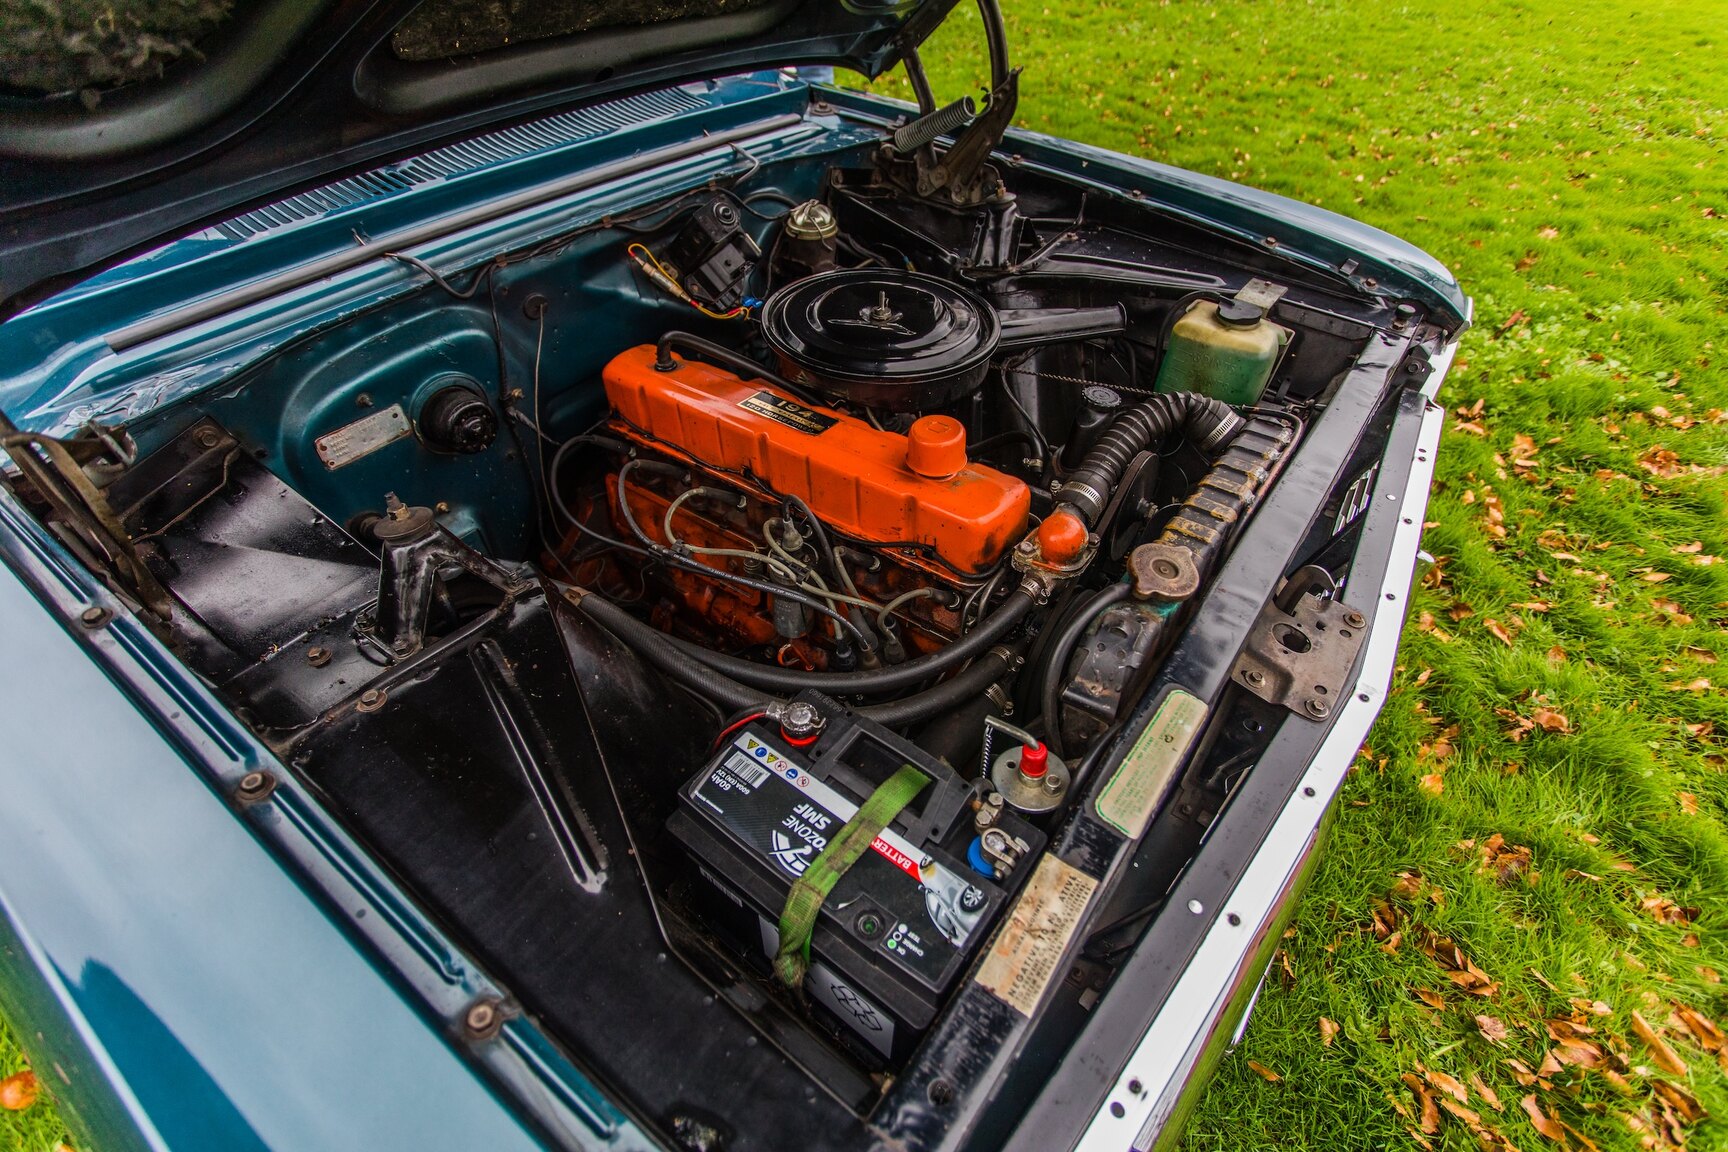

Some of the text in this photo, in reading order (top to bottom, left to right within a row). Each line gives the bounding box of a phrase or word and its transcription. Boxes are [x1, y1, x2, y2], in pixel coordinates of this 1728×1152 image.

[746, 403, 761, 411] 120
[761, 409, 815, 432] HORSEPOWER
[776, 400, 814, 417] 194
[711, 773, 731, 791] 60Ah
[715, 769, 727, 781] 12V
[735, 781, 750, 795] 600A
[793, 803, 832, 830] SMF
[1007, 943, 1041, 997] NEGATIVE
[1036, 926, 1049, 941] TO
[1047, 874, 1077, 925] NATIVE
[902, 938, 924, 957] CHARGE
